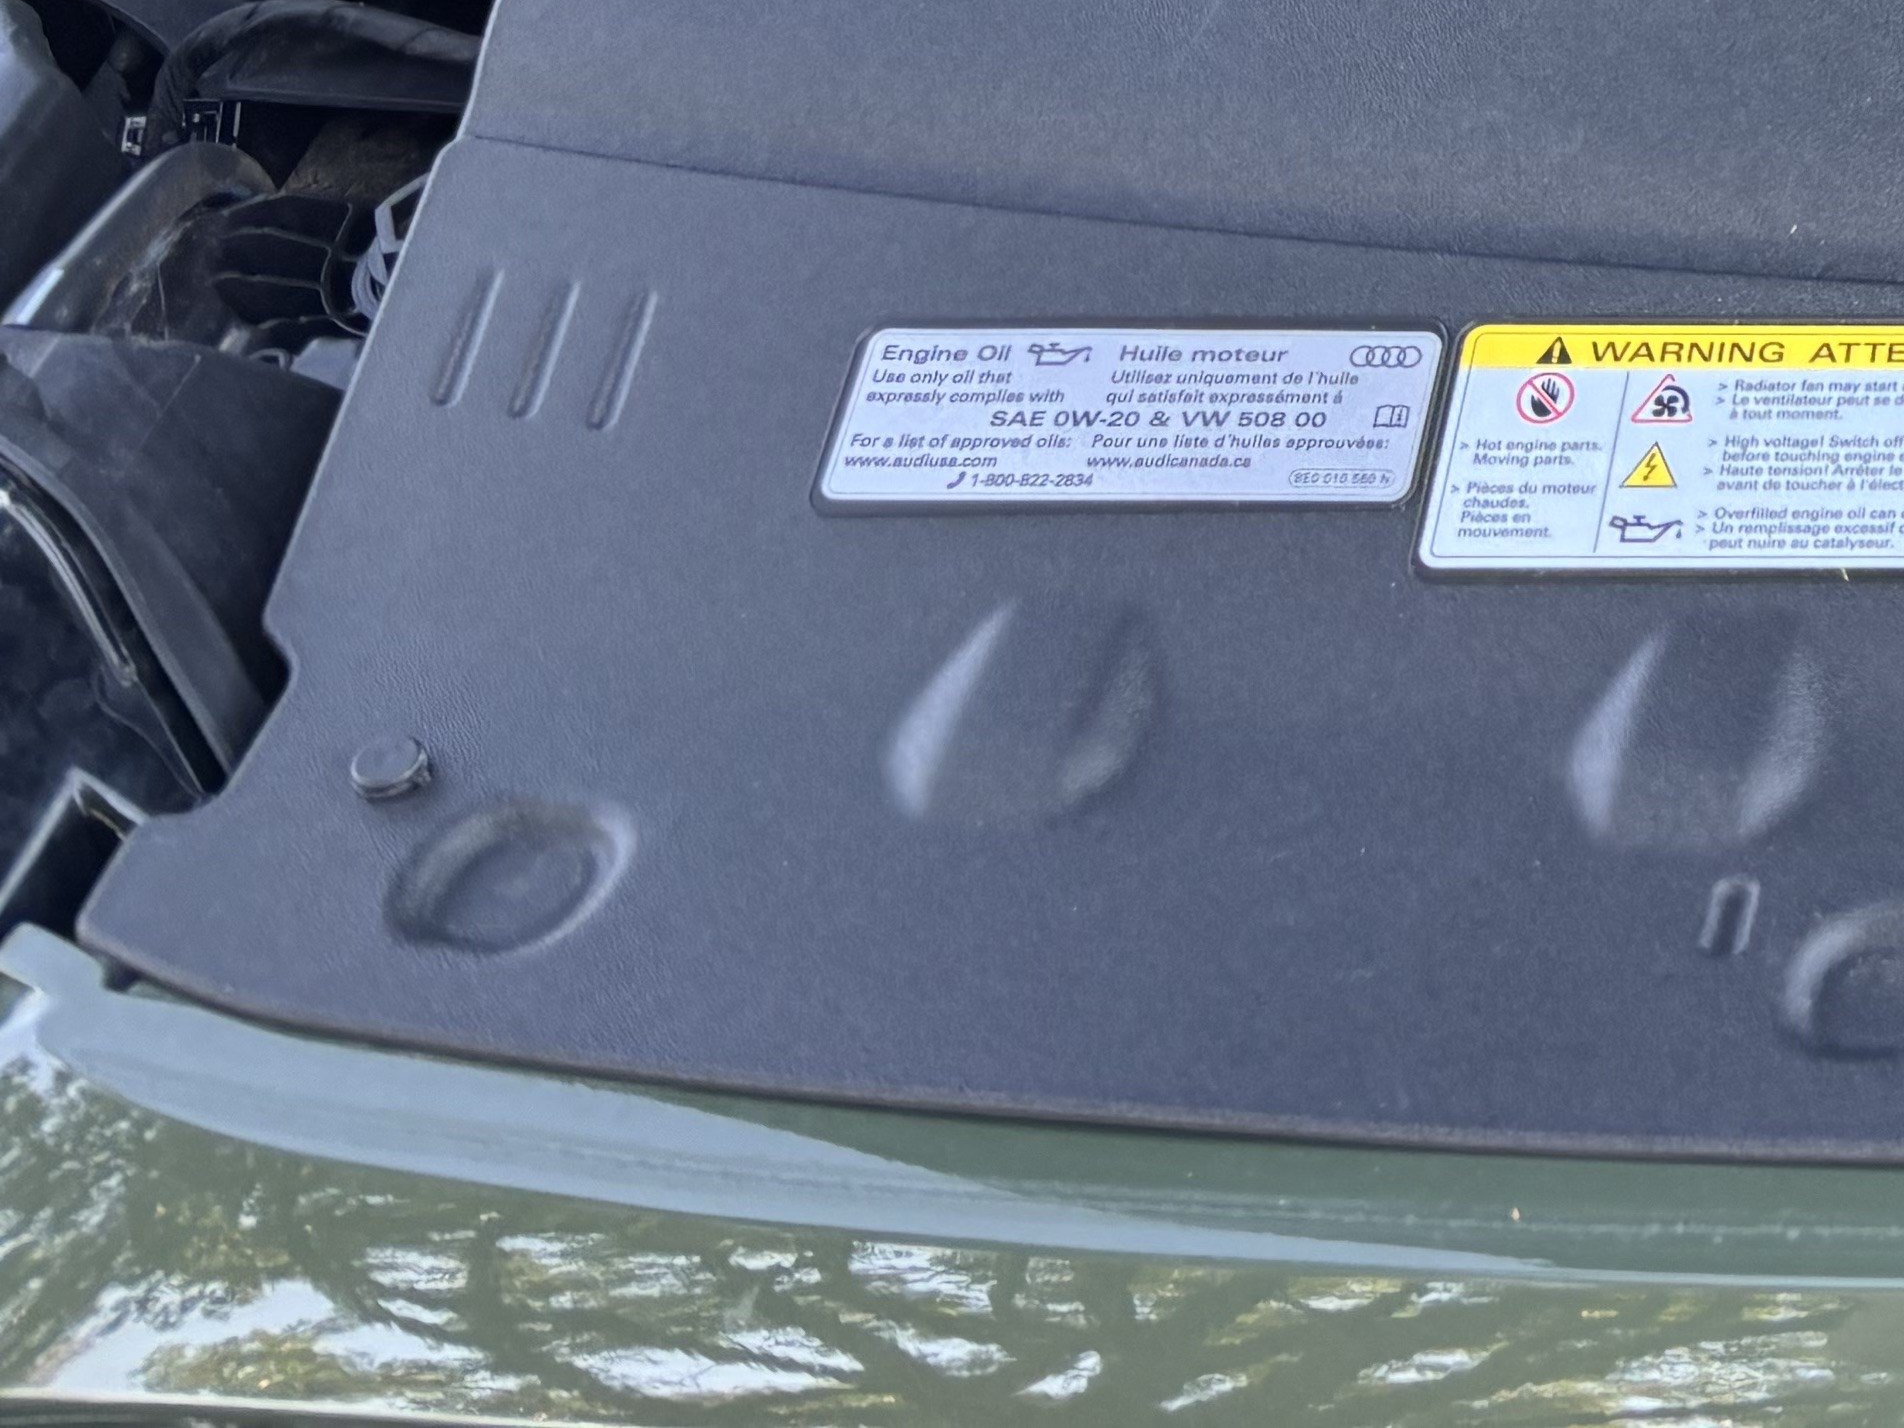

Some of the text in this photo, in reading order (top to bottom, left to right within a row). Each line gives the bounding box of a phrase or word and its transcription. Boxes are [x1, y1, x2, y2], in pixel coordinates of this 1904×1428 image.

[882, 344, 1012, 364] Engine Oil
[1120, 345, 1288, 362] Huile moteur
[1591, 341, 1786, 363] WARNING
[872, 370, 1012, 386] Use only oil that
[1111, 371, 1358, 387] Utilisez uniquement de l'huile
[1734, 378, 1797, 392] Radiator
[1801, 379, 1825, 392] fan
[1829, 381, 1861, 395] may
[1865, 379, 1898, 393] start
[866, 390, 1064, 405] expressly complies with
[1106, 390, 1134, 406] qui
[1138, 390, 1204, 403] satisfait
[1209, 390, 1329, 407] expressément
[1732, 393, 1749, 407] Le
[1753, 393, 1833, 407] ventilateur
[1836, 395, 1871, 410] peut
[1874, 397, 1890, 407] se
[990, 411, 1327, 428] SAE 0W-20 & VW 508 00
[1742, 408, 1773, 420] tout
[1776, 408, 1843, 420] moment.
[850, 434, 1072, 450] For a list of approved oils:
[1091, 434, 1390, 451] Pour une liste d'huiles approuvées:
[1476, 439, 1603, 455] Hot engine parts.
[1724, 435, 1760, 451] High
[1764, 435, 1825, 452] voltage!
[1828, 435, 1880, 449] Switch
[1884, 435, 1904, 449] off
[844, 454, 998, 468] www.audiusa.com
[1087, 455, 1252, 469] www.audicanada.ca
[1473, 453, 1575, 468] Moving parts.
[1722, 448, 1771, 463] before
[1774, 448, 1840, 464] touching
[1843, 450, 1896, 465] engine
[1719, 463, 1764, 477] Haute
[1768, 463, 1827, 477] tension!
[1832, 462, 1886, 477] Arrêter
[1889, 463, 1903, 477] le
[972, 473, 1093, 488] 1-800-822-2834
[1466, 480, 1597, 495] Pièces du moteur
[1716, 478, 1758, 492] avant
[1762, 477, 1782, 492] de
[1786, 477, 1843, 492] toucher
[1463, 496, 1530, 509] chaudes.
[1460, 510, 1531, 523] Pièces en
[1714, 506, 1788, 521] Overfilled
[1792, 508, 1847, 522] engine
[1850, 507, 1866, 521] oil
[1869, 509, 1898, 521] can
[1458, 526, 1552, 538] mouvement.
[1712, 522, 1735, 535] Un
[1738, 522, 1830, 538] remplissage
[1833, 521, 1894, 536] excessif
[1708, 535, 1895, 551] peut nuire au catalyseur.
